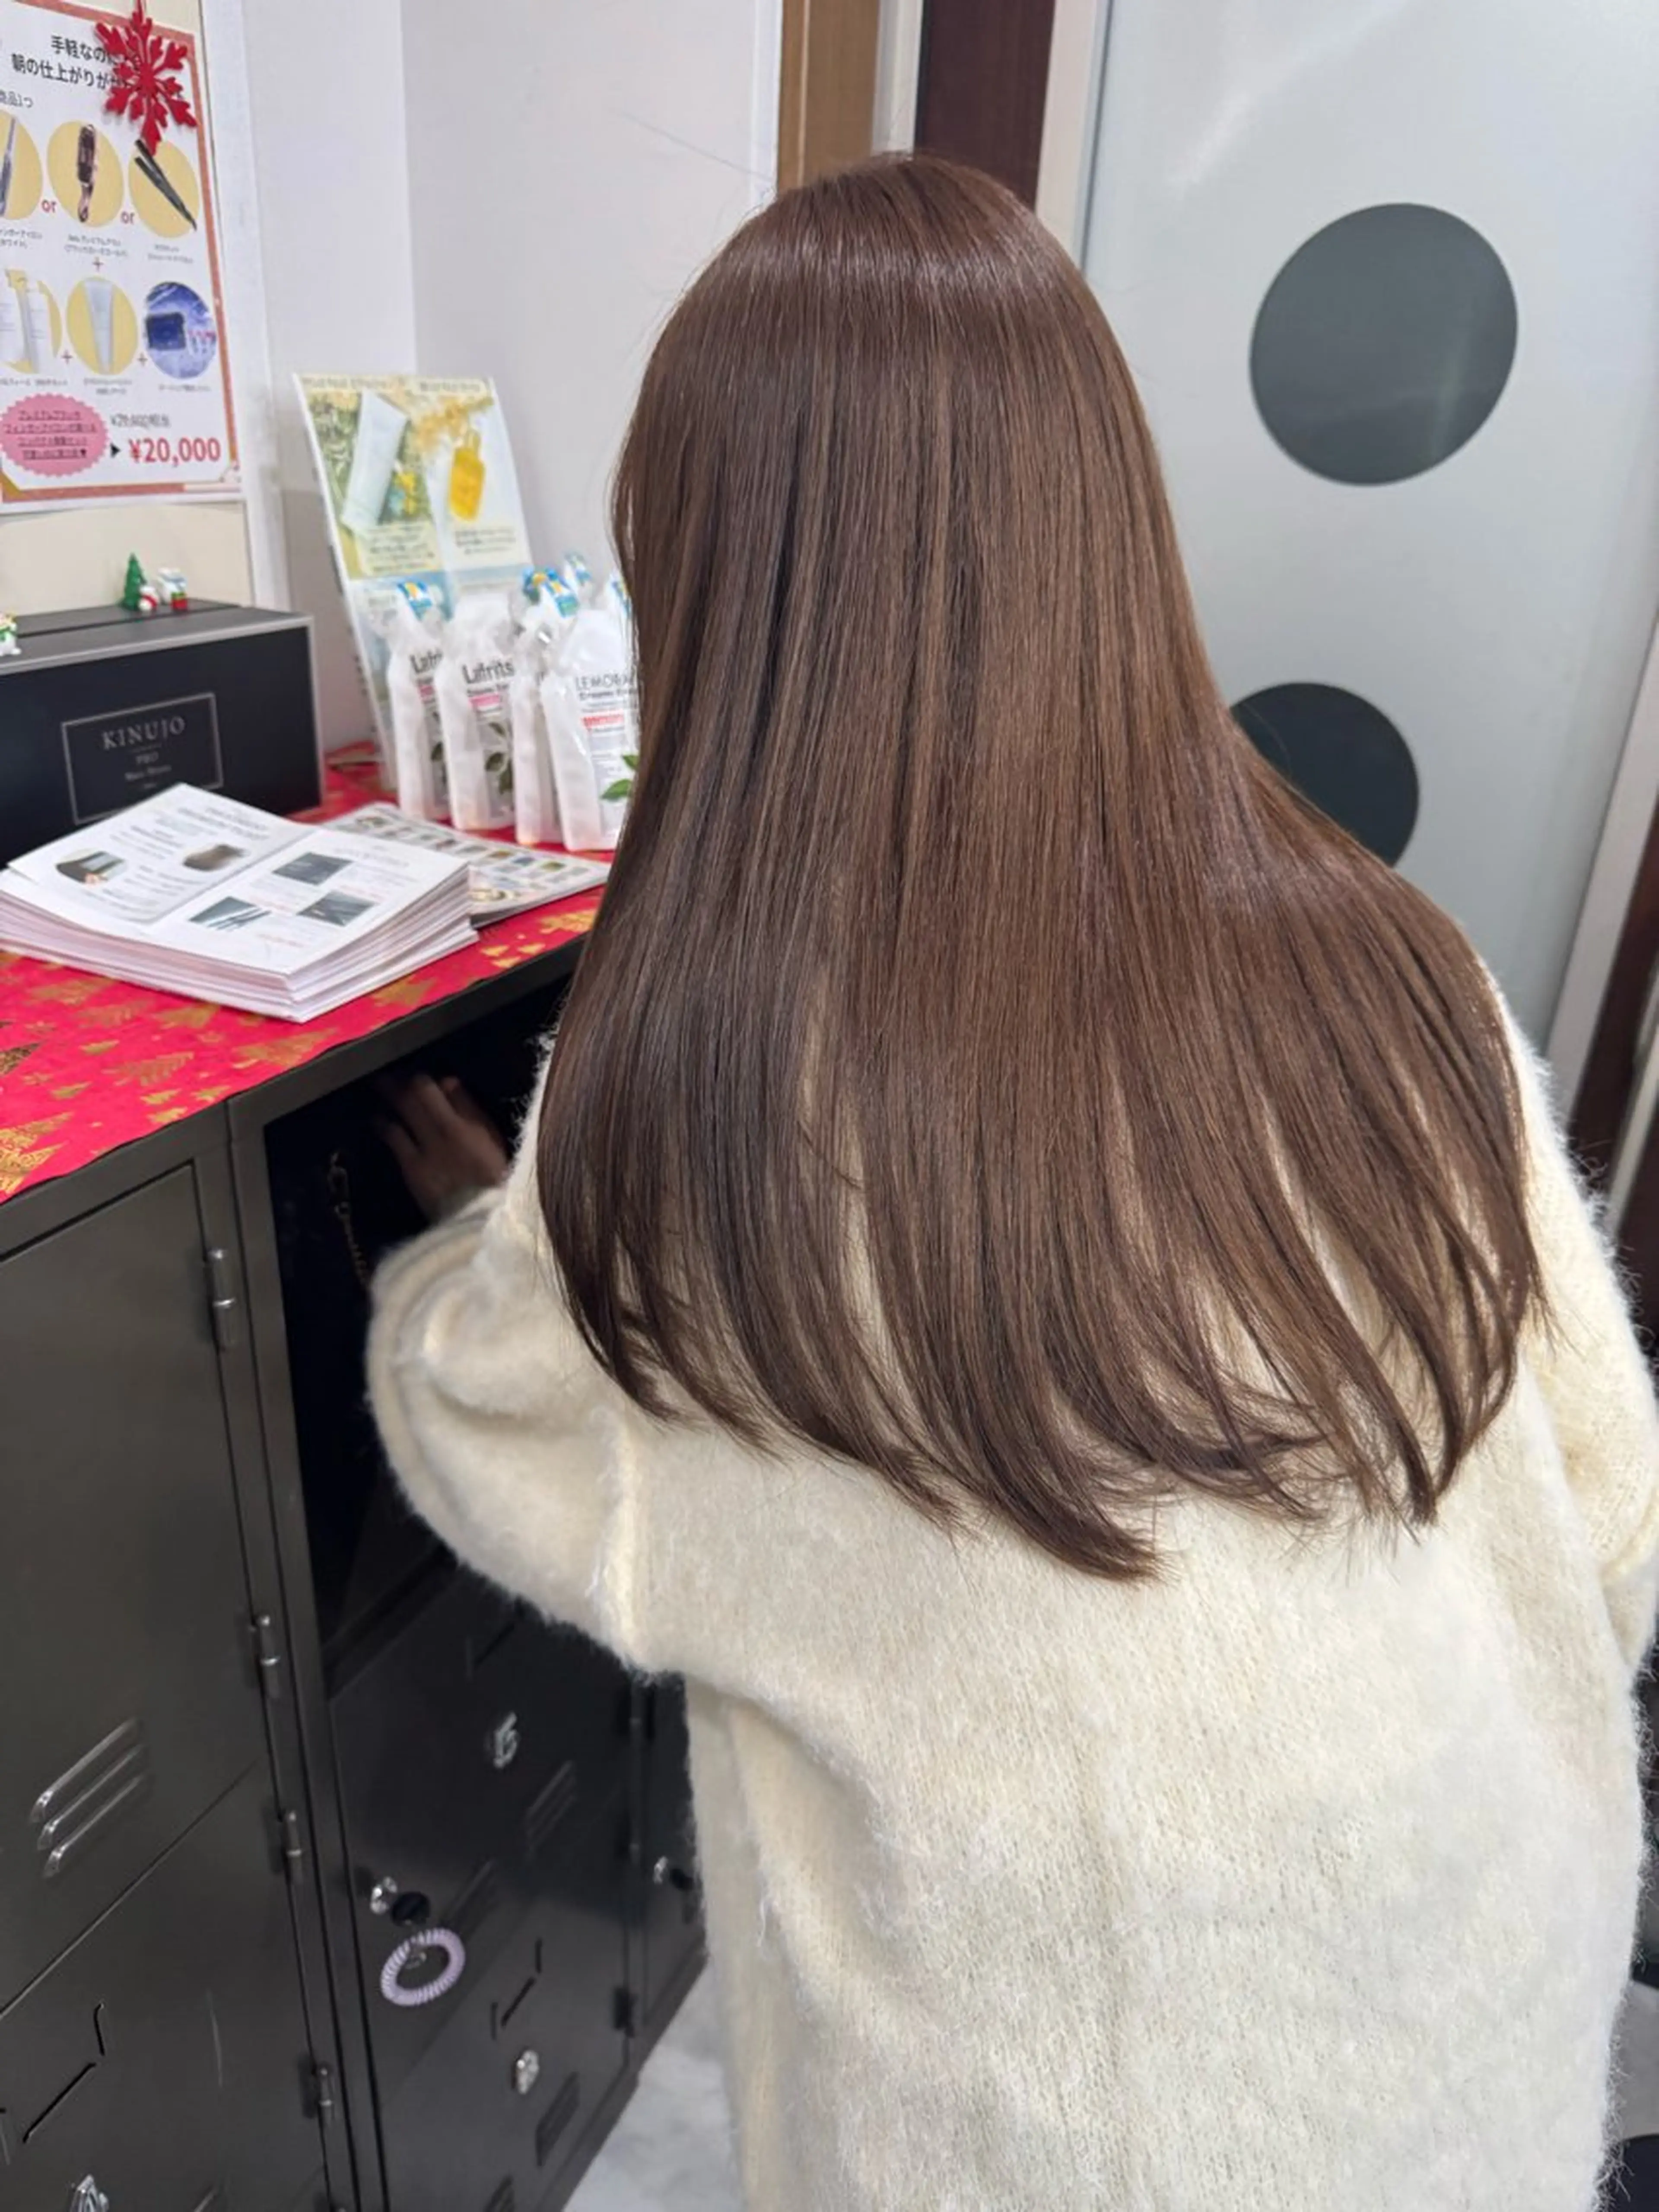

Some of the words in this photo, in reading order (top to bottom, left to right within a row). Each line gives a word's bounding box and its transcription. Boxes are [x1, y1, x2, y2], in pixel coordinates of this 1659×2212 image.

[41, 199, 56, 213] or
[121, 211, 135, 224] or
[129, 437, 221, 467] ¥20,000
[102, 715, 185, 750] KINUJO
